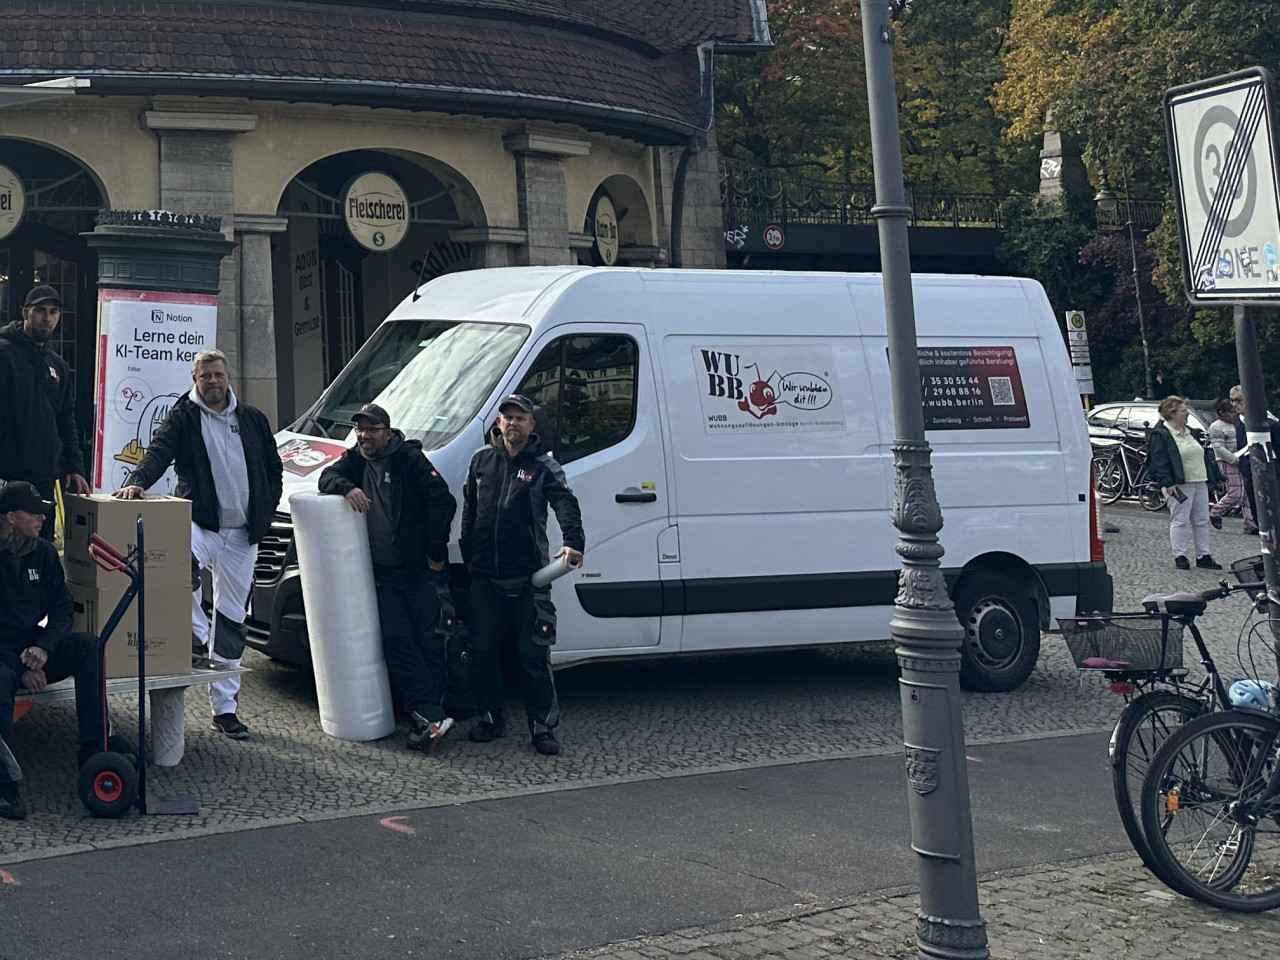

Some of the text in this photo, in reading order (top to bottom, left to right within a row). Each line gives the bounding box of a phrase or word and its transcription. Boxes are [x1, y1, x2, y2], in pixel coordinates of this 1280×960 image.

[348, 197, 406, 220] Fleischerei
[166, 313, 193, 323] Notion
[134, 328, 204, 346] Lerne dein
[116, 344, 173, 361] KI-Team
[700, 349, 740, 377] WU
[708, 373, 744, 400] BB
[782, 380, 797, 392] Wir
[930, 376, 941, 385] 35
[943, 376, 954, 385] 30
[955, 376, 967, 385] 55
[968, 376, 979, 385] 44
[933, 387, 943, 396] 29
[945, 387, 957, 396] 68
[958, 387, 970, 396] 88
[971, 387, 981, 395] 16
